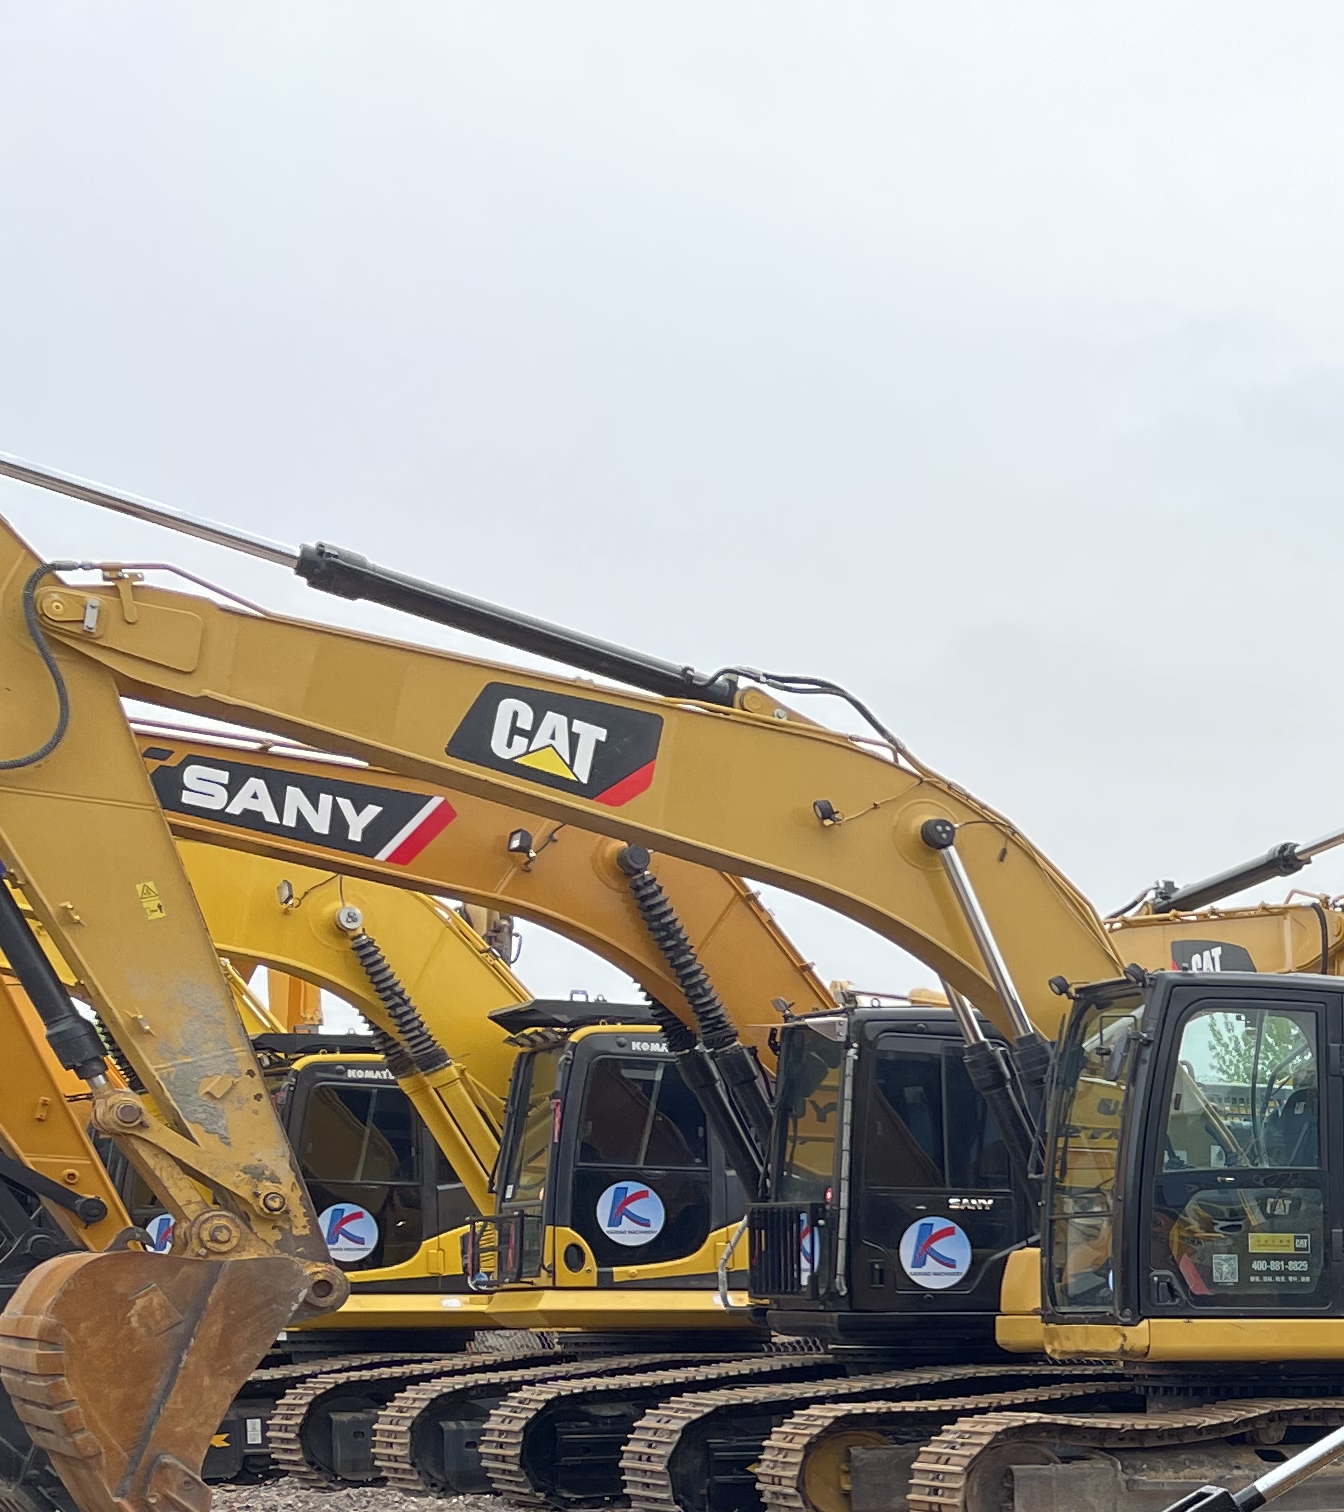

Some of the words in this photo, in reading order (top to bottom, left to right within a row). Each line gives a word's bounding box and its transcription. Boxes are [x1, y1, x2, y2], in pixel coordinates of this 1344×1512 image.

[491, 698, 607, 784] CAT
[181, 764, 383, 842] SANY
[1191, 946, 1222, 972] CAT
[948, 1198, 994, 1210] SANY
